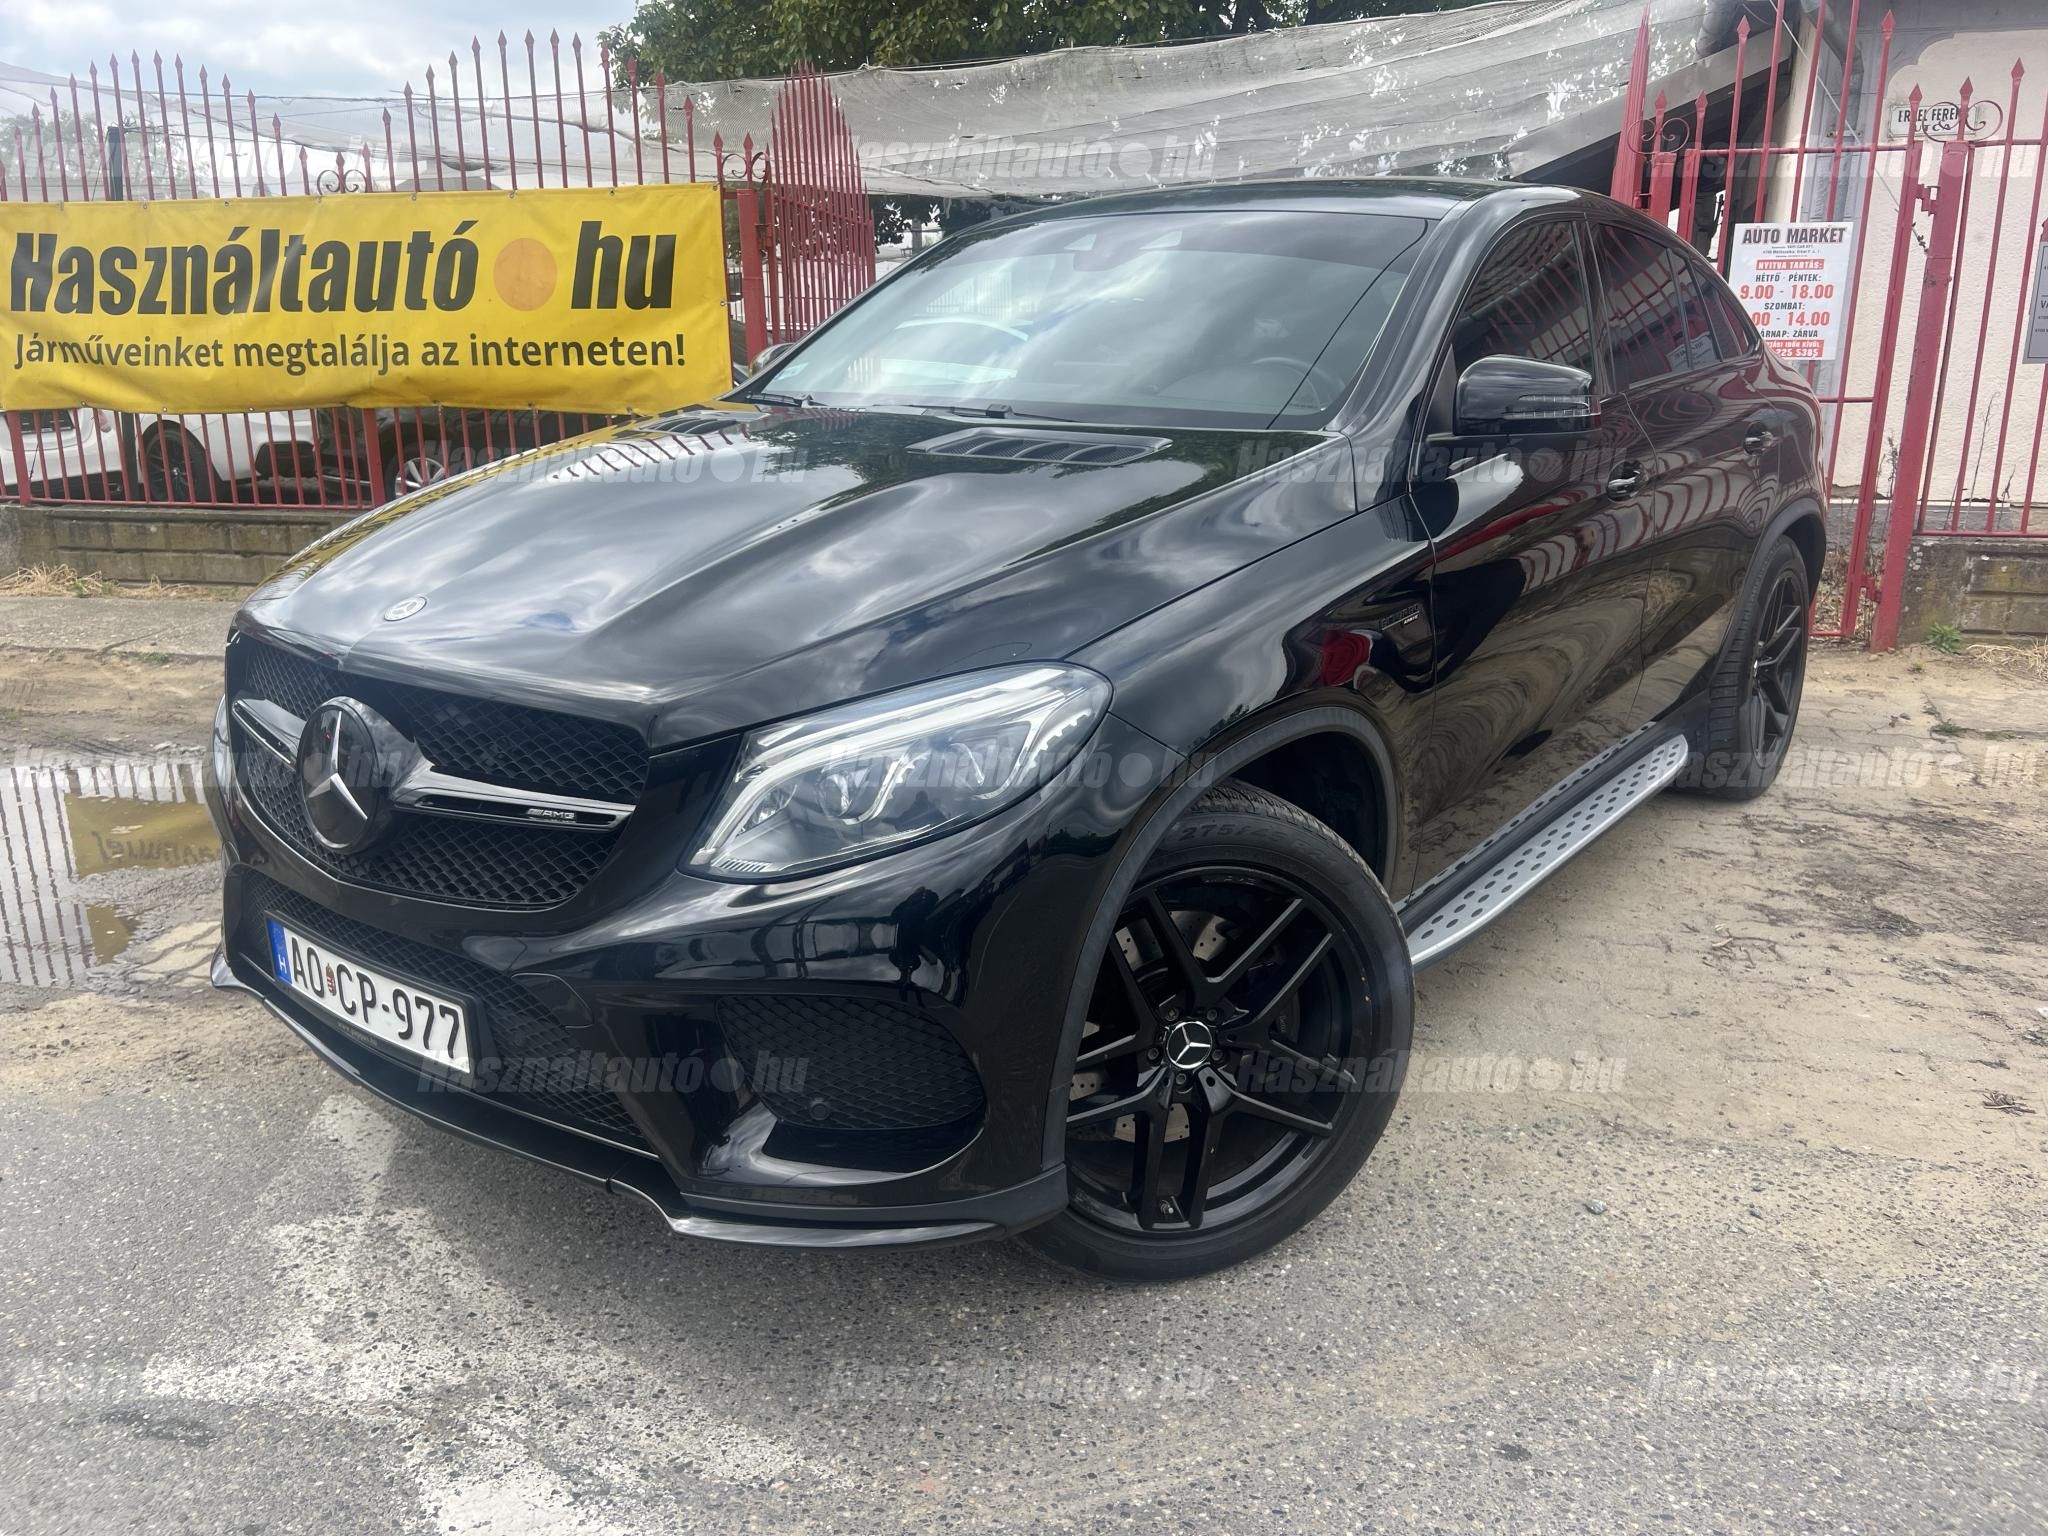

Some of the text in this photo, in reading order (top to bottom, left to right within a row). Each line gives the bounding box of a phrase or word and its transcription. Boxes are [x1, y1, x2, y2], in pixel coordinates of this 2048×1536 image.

[1898, 109, 1927, 122] EREL
[1742, 226, 1847, 244] AUTO MARKET
[10, 219, 677, 316] Használtautó hu
[1757, 261, 1787, 270] NYITVA
[1755, 271, 1781, 282] HÉTFŐ
[1788, 271, 1822, 282] PÉNTEK:
[1740, 284, 1774, 299] 9.00
[1791, 284, 1834, 299] 18.00
[1764, 302, 1805, 310] SZOMBAT:
[1787, 311, 1830, 326] 14.00
[1792, 328, 1818, 338] ZÁRVA
[14, 332, 686, 376] Járműveinket megtalálja az interneten!
[335, 961, 460, 1060] CP-977
